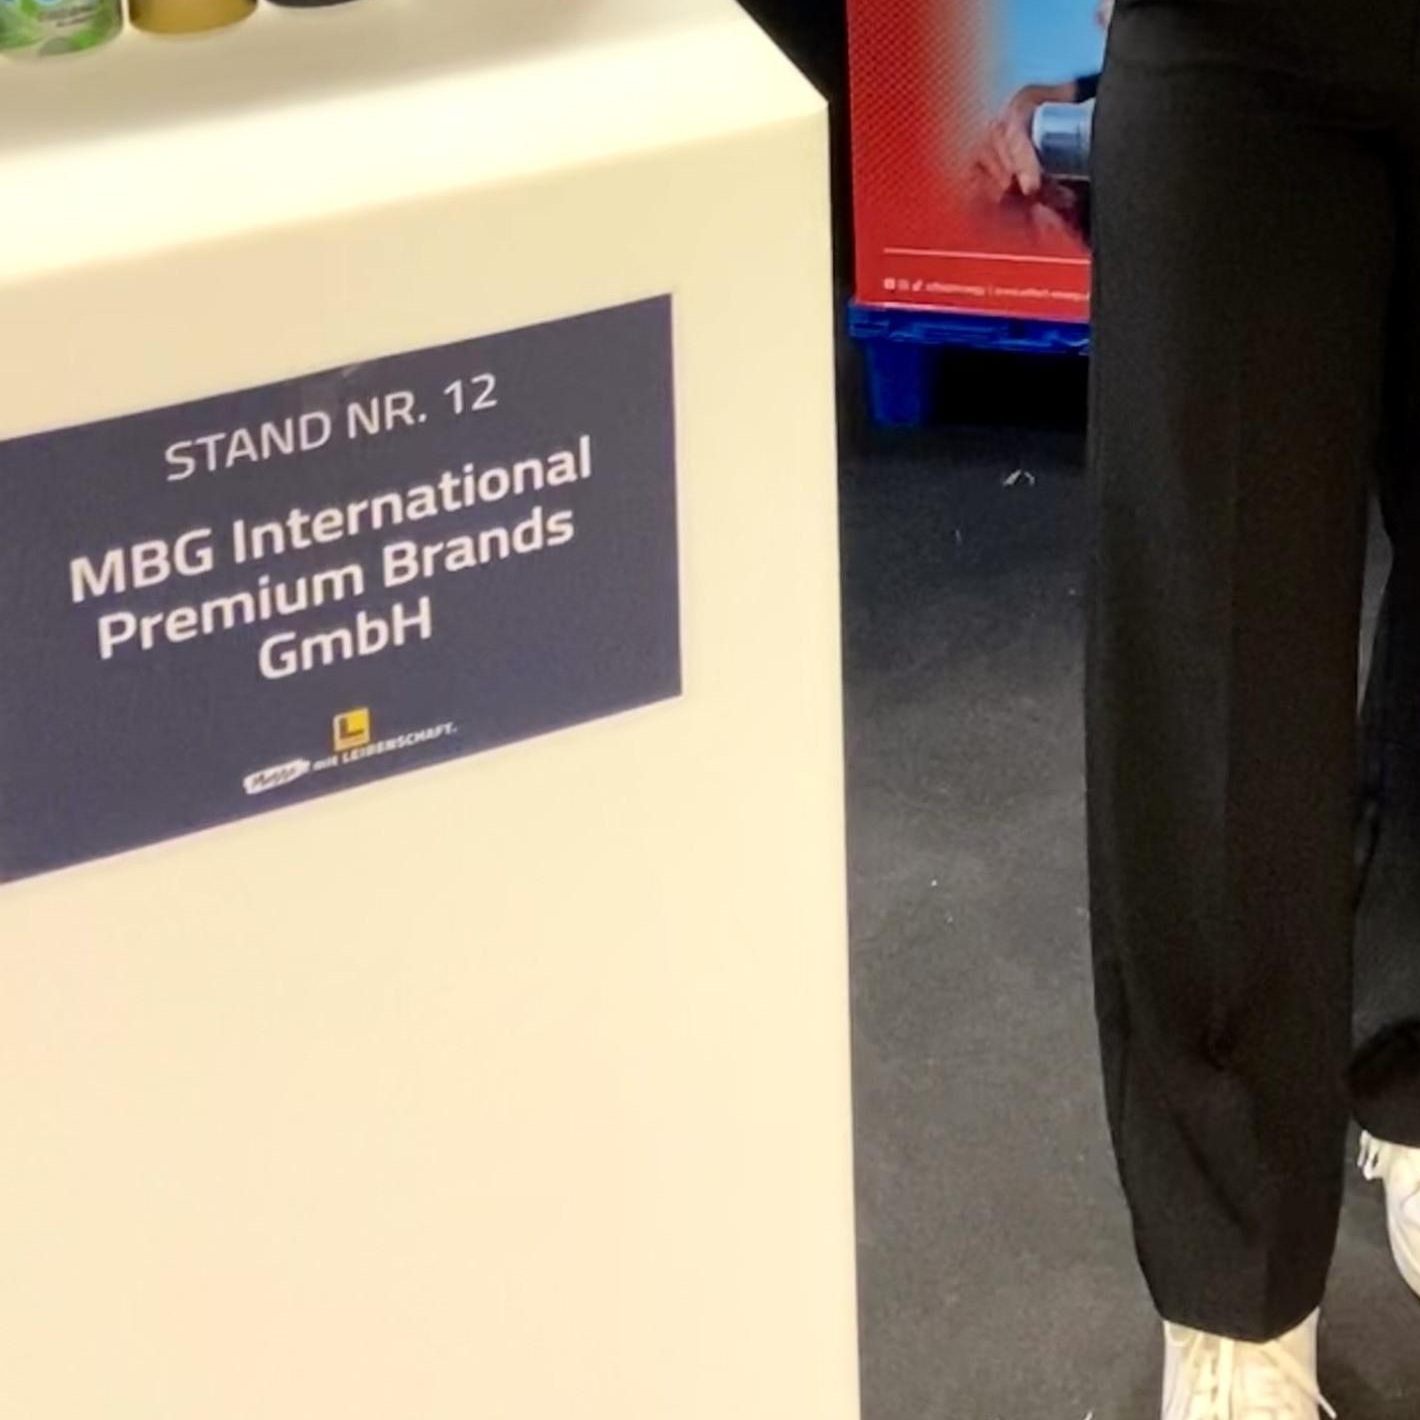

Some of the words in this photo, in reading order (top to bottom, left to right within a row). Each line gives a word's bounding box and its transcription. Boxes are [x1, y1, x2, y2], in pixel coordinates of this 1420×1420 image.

[164, 410, 331, 481] STAND
[346, 390, 429, 440] NR.
[443, 373, 498, 416] 12
[69, 527, 214, 602] MBG
[232, 435, 592, 563] International
[97, 559, 364, 659] Premium
[382, 508, 574, 587] Brands
[258, 597, 432, 680] GmbH
